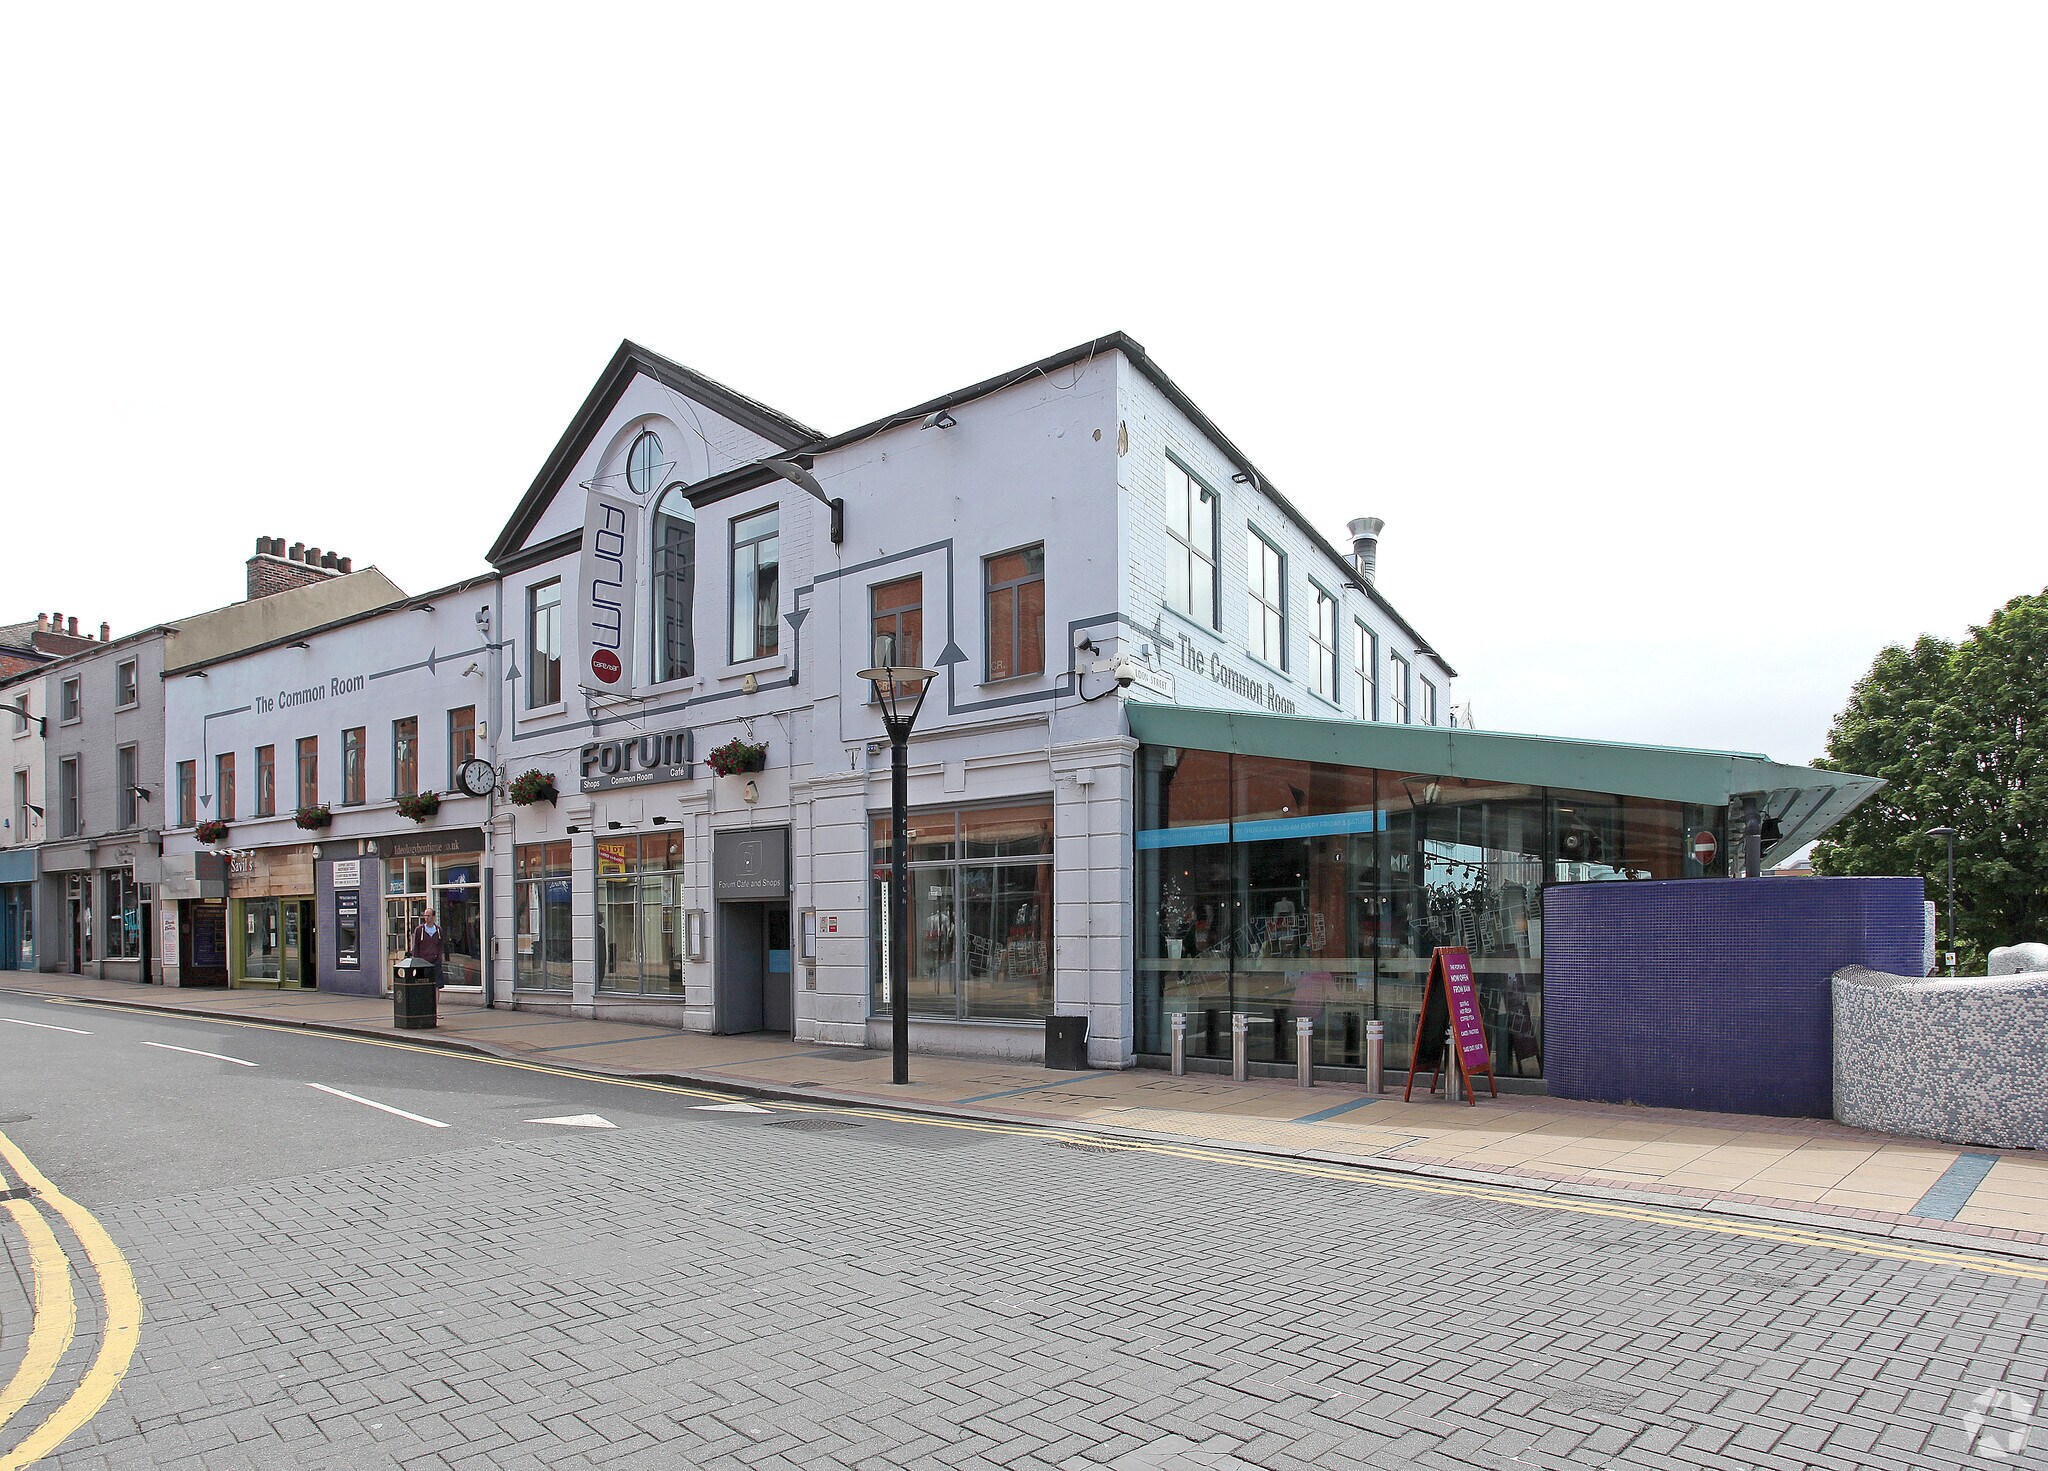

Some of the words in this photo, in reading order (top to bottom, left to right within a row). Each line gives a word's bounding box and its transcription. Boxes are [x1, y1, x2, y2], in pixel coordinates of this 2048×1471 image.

[1150, 674, 1168, 691] STREET
[1178, 632, 1204, 676] The
[1210, 652, 1263, 705] Common
[1267, 682, 1296, 714] Room
[255, 696, 274, 714] The
[278, 685, 325, 709] Common
[330, 675, 364, 697] Room
[583, 780, 600, 789] Shops
[611, 775, 636, 785] Common
[636, 772, 654, 782] Room
[669, 767, 685, 777] Café
[718, 880, 735, 889] Forum
[750, 879, 762, 887] and
[762, 878, 781, 888] Shops
